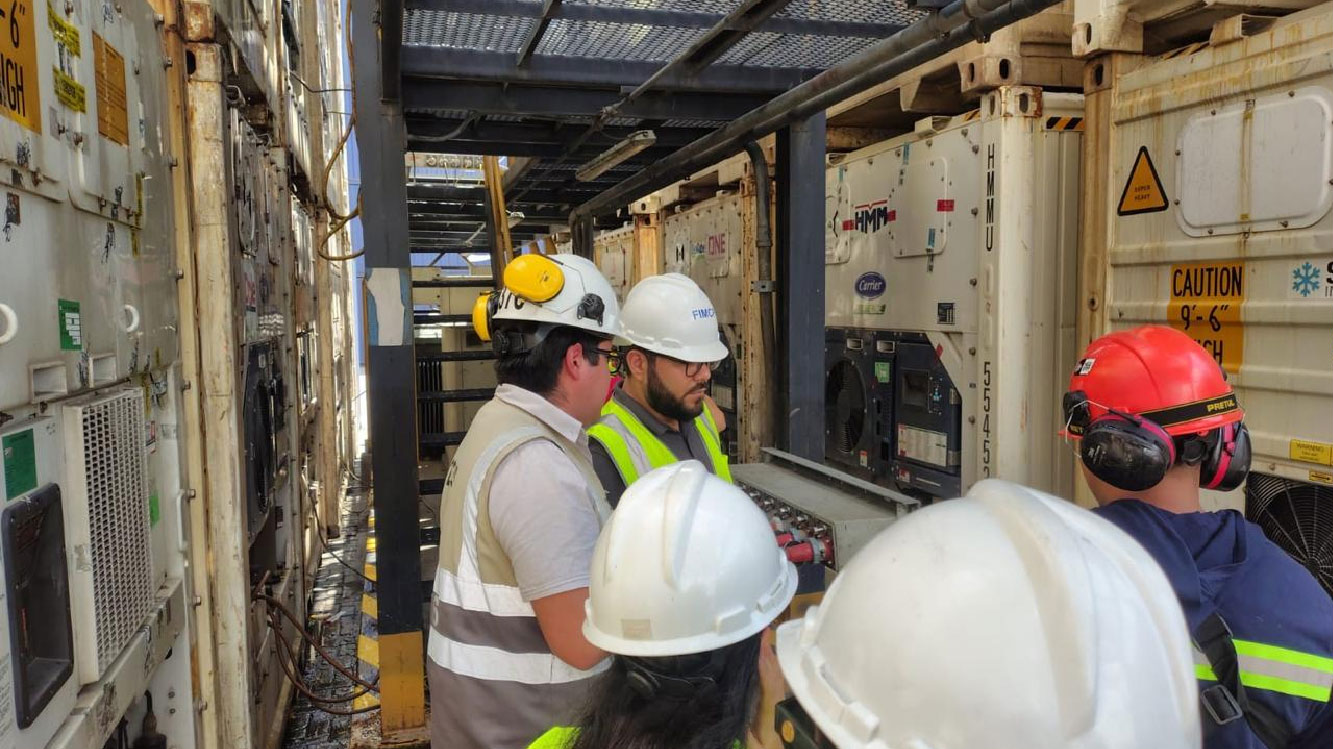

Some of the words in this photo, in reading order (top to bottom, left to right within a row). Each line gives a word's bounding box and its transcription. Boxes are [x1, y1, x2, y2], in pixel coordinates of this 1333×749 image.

[854, 206, 888, 234] HMM
[709, 233, 726, 256] ONE
[859, 280, 883, 293] Carrier
[1173, 266, 1242, 297] CAUTION
[692, 308, 715, 320] FIMC
[1207, 400, 1235, 412] PRETUL
